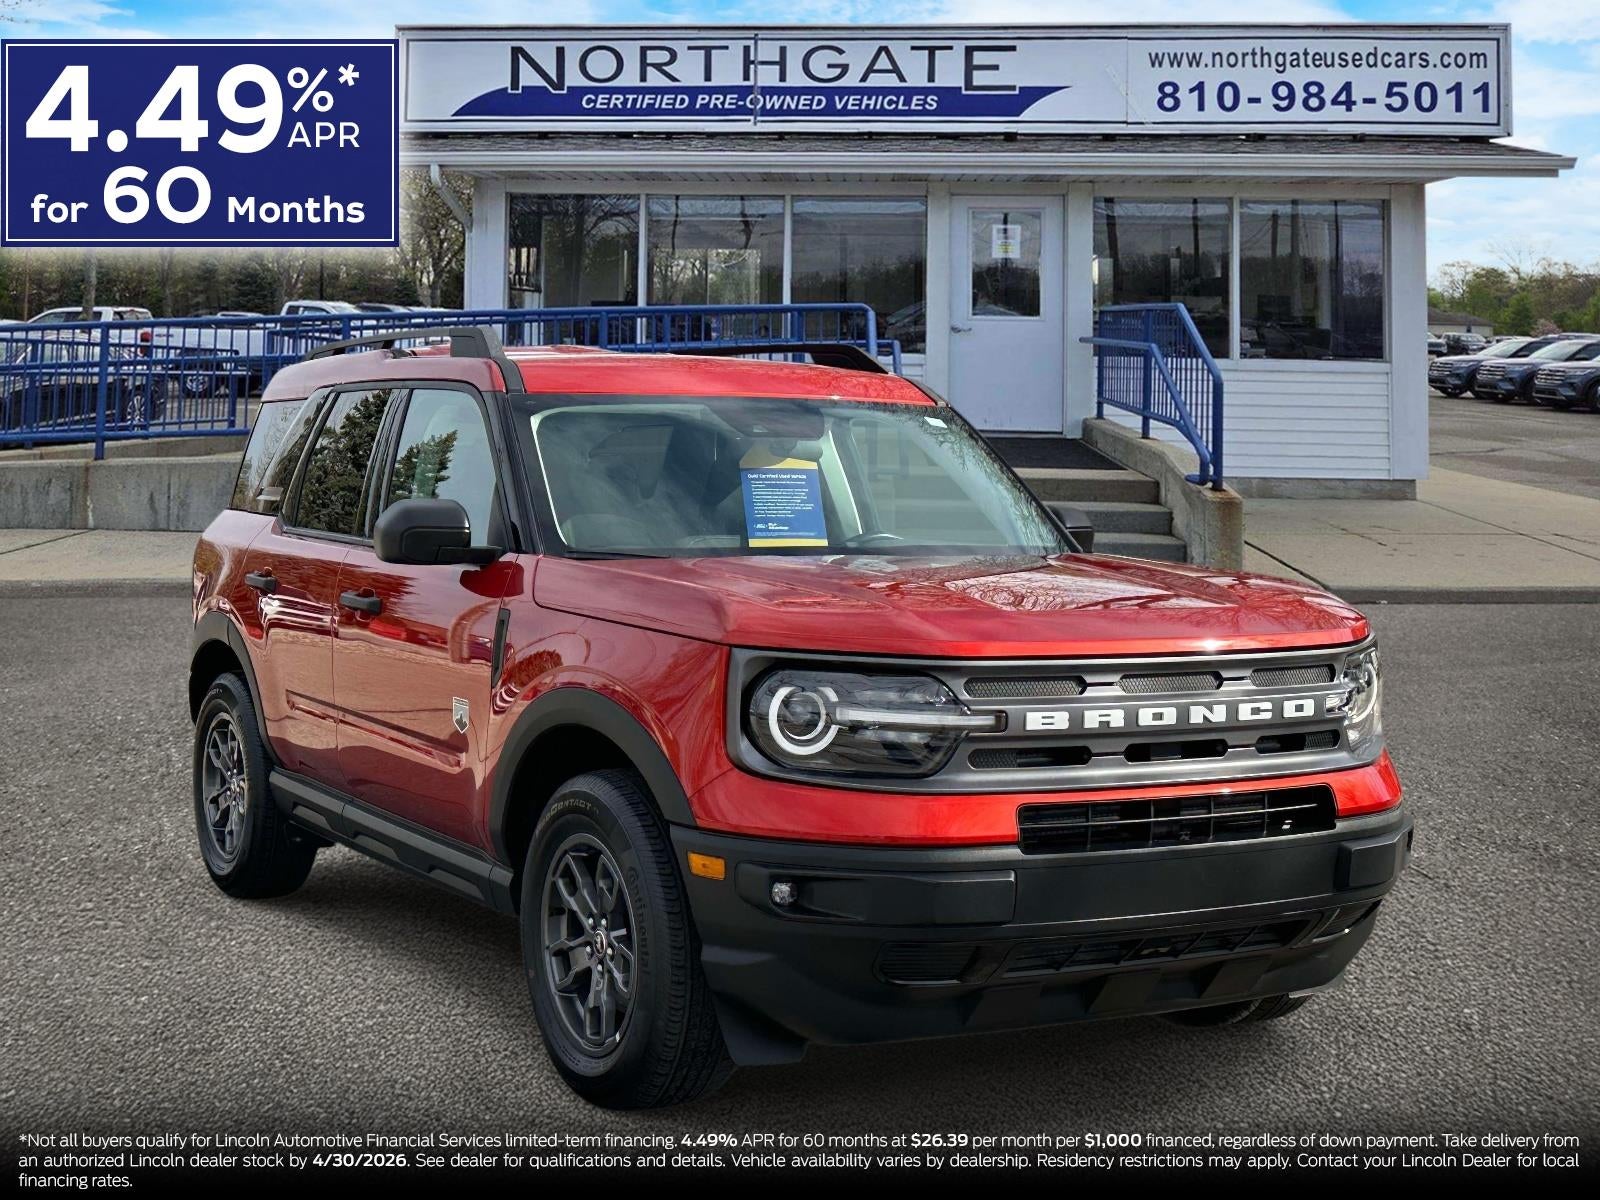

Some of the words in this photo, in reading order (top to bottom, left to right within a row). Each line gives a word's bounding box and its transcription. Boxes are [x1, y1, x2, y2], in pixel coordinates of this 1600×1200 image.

[510, 45, 1017, 92] NORTHGATE
[1149, 47, 1488, 74] www.northgateusedcars.com
[581, 94, 689, 110] CERTIFIED
[695, 94, 827, 111] PRE-OWNED
[834, 95, 939, 111] VEHICLES
[1156, 81, 1492, 113] 810-984-5011
[1025, 698, 1315, 731] BRONCO
